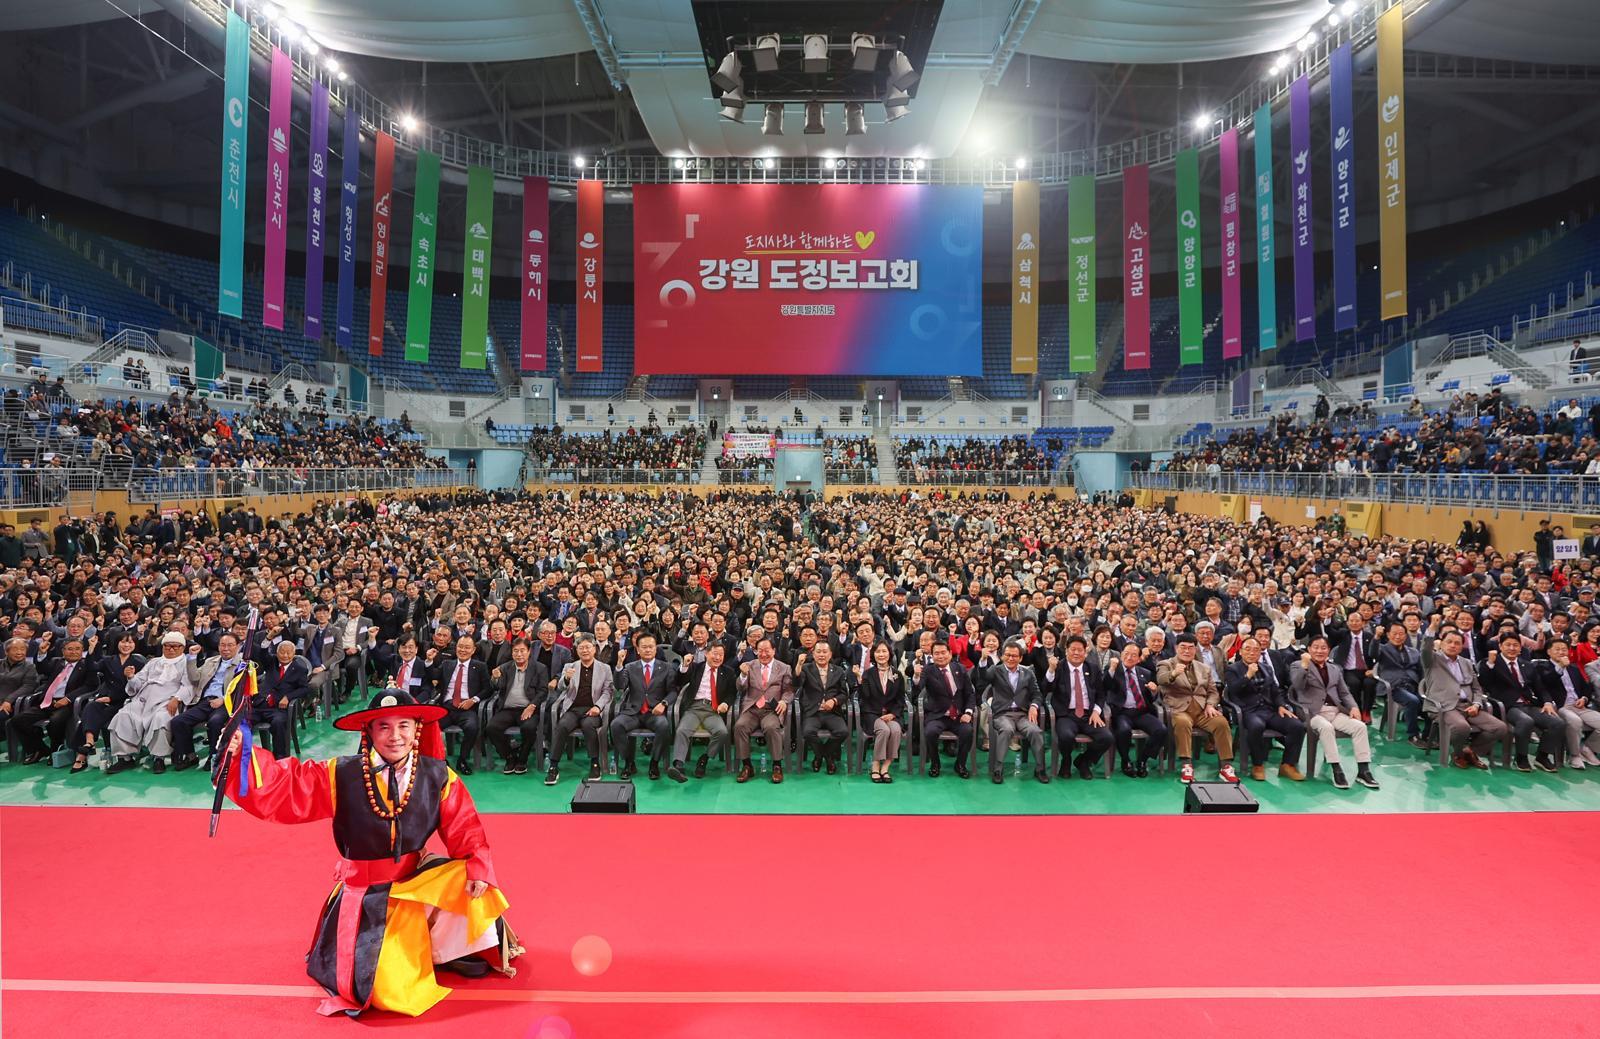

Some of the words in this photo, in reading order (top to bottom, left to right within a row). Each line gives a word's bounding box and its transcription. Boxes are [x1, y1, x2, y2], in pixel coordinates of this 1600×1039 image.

[227, 137, 240, 209] 춘천시
[1337, 159, 1350, 228] 양구군
[1384, 133, 1401, 208] 인제군
[271, 162, 283, 230] 원주시
[312, 187, 322, 247] 홍천군
[1297, 182, 1309, 246] 화천군
[344, 206, 353, 263] 횡성군
[375, 222, 387, 276] 영월군
[744, 232, 796, 250] 도지사와
[798, 231, 853, 251] 함께하는
[1226, 221, 1236, 277] 평창군
[416, 237, 430, 287] 속초시
[470, 249, 485, 297] 태백시
[528, 254, 542, 301] 동해시
[583, 258, 597, 303] 강릉시
[699, 259, 760, 290] 강원
[769, 259, 919, 291] 도정보고회
[1019, 259, 1032, 305] 삼척시
[1075, 255, 1090, 303] 정선군
[1130, 248, 1144, 297] 고성군
[1184, 237, 1196, 288] 양양군
[531, 384, 543, 393] G7
[710, 386, 722, 394] G8
[875, 387, 887, 395] G9
[1052, 386, 1069, 395] G10
